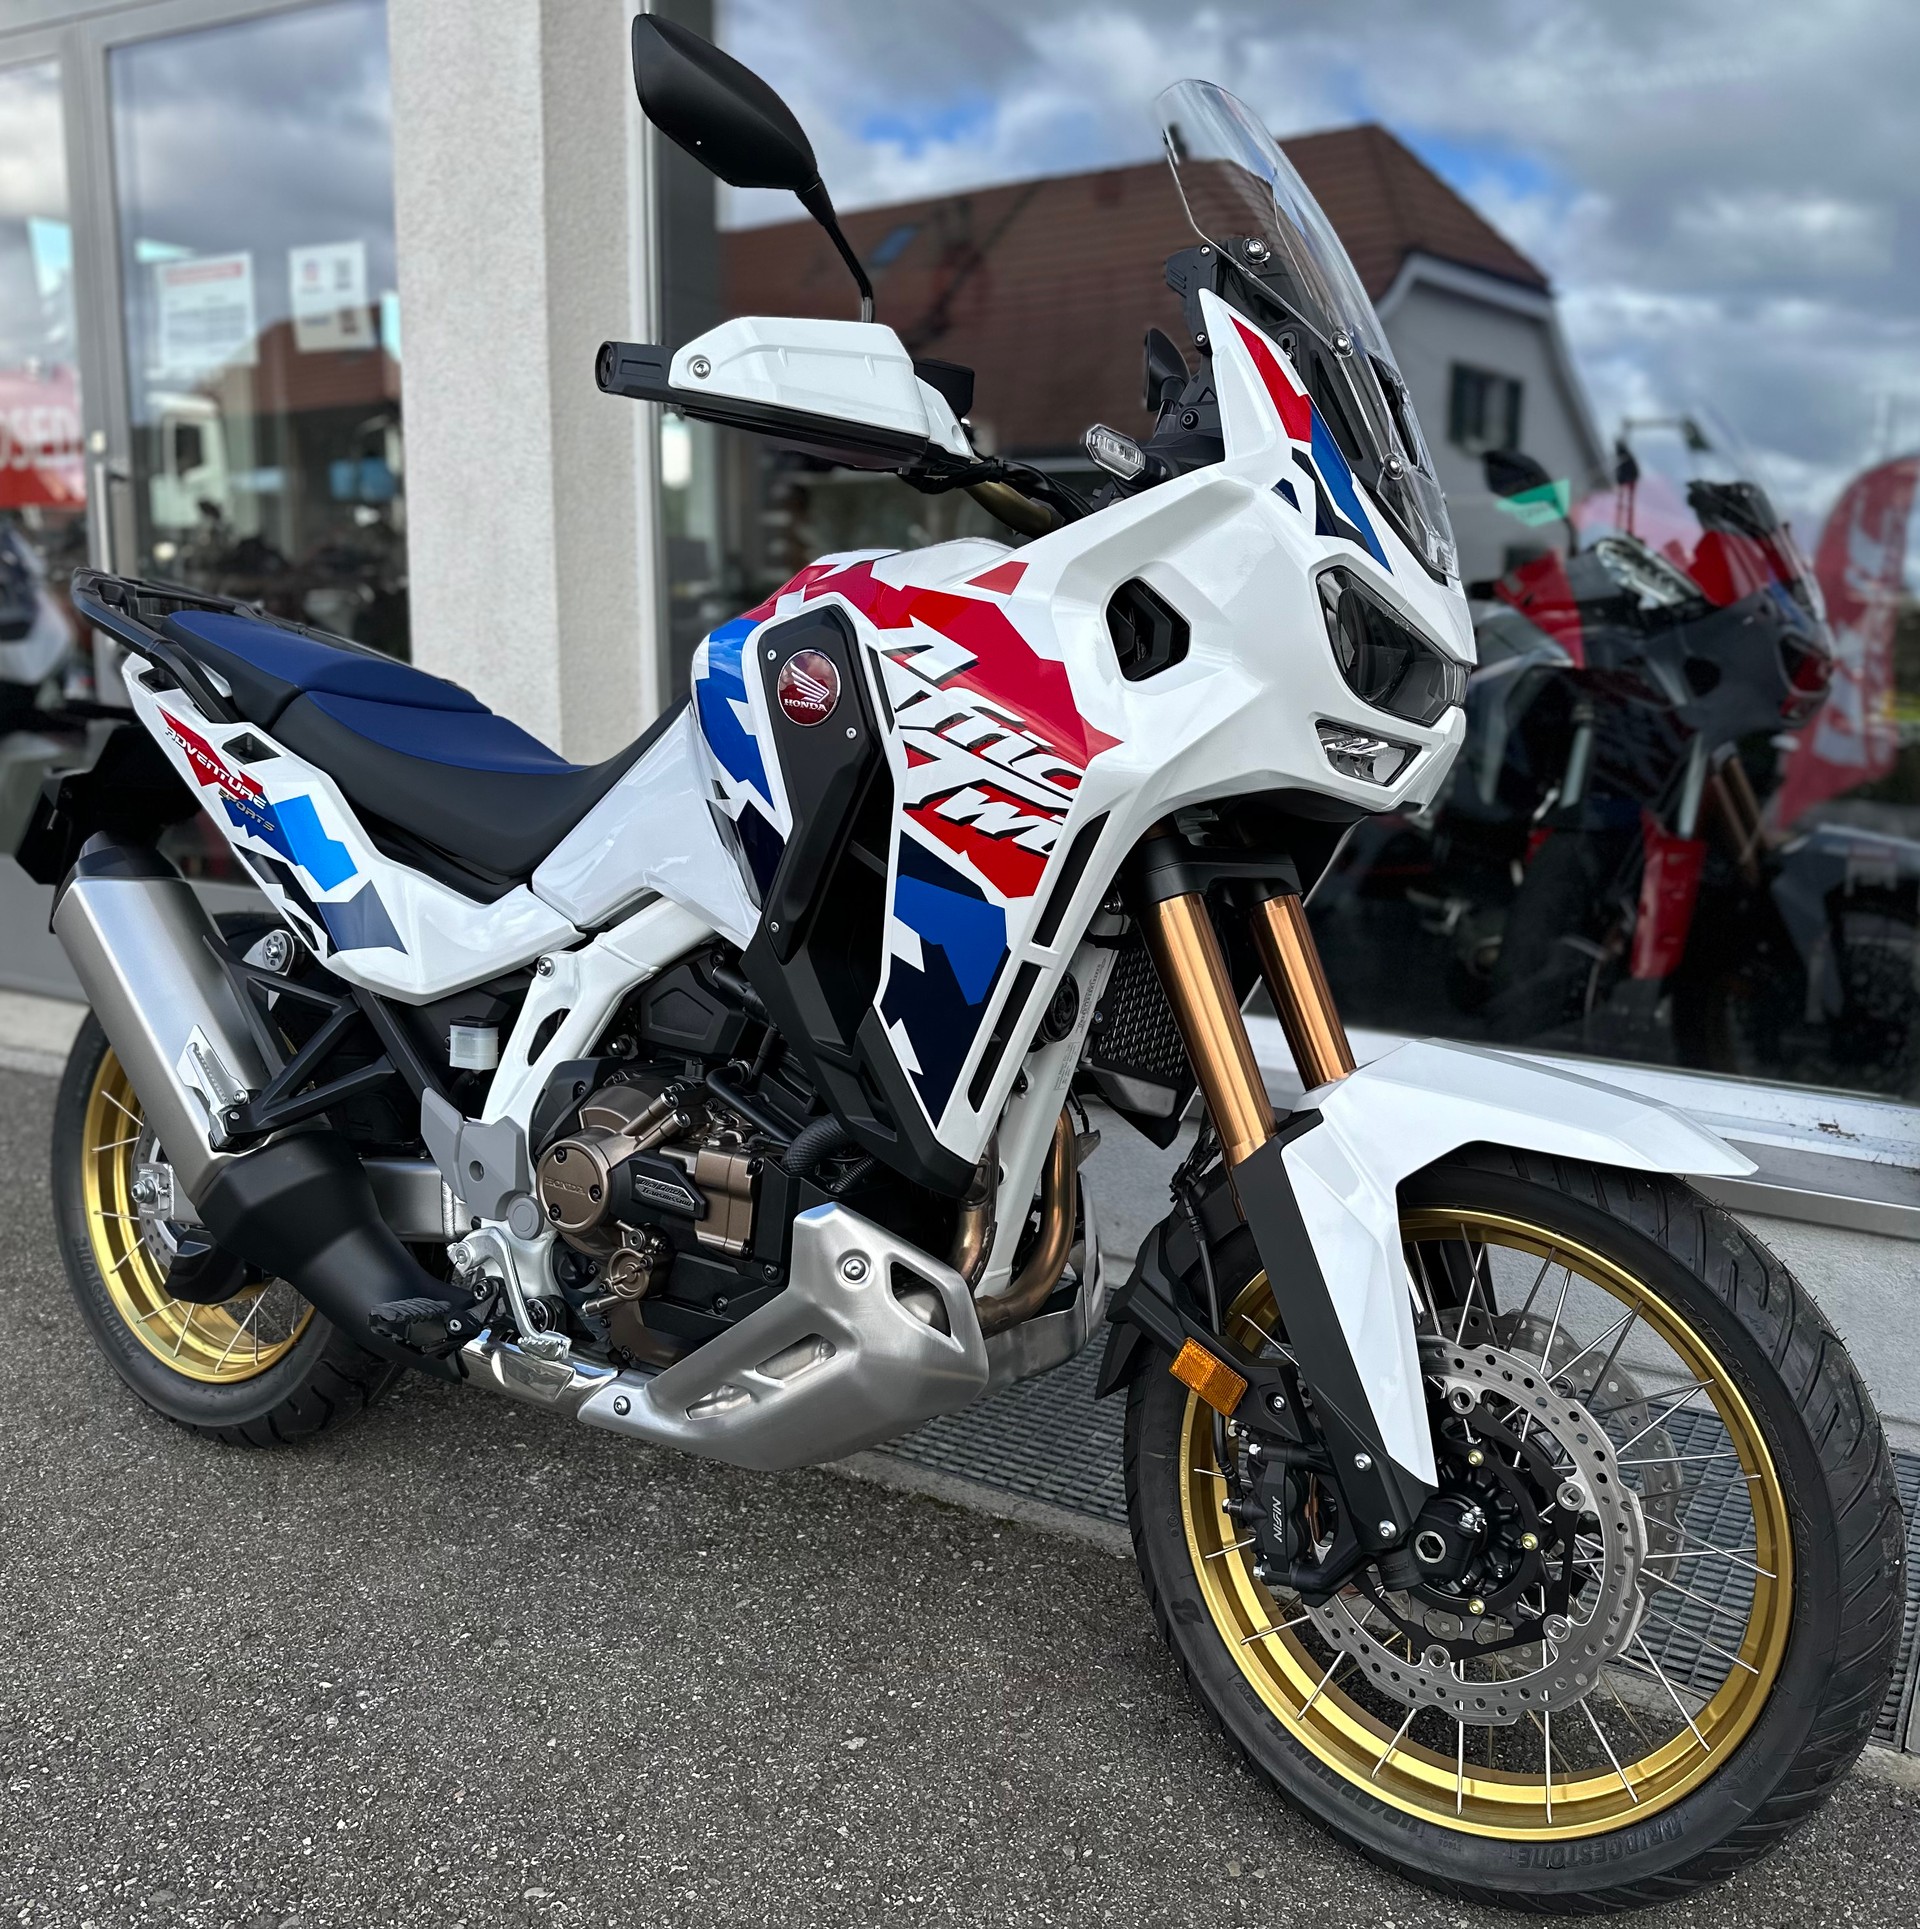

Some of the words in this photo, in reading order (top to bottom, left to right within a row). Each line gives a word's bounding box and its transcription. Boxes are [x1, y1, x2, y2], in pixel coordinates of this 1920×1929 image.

[783, 698, 829, 713] HONDA
[164, 725, 267, 810] ADVENTURE
[217, 787, 276, 833] SPORTS
[544, 1177, 586, 1196] HONDA
[1271, 1495, 1284, 1543] NISSIN
